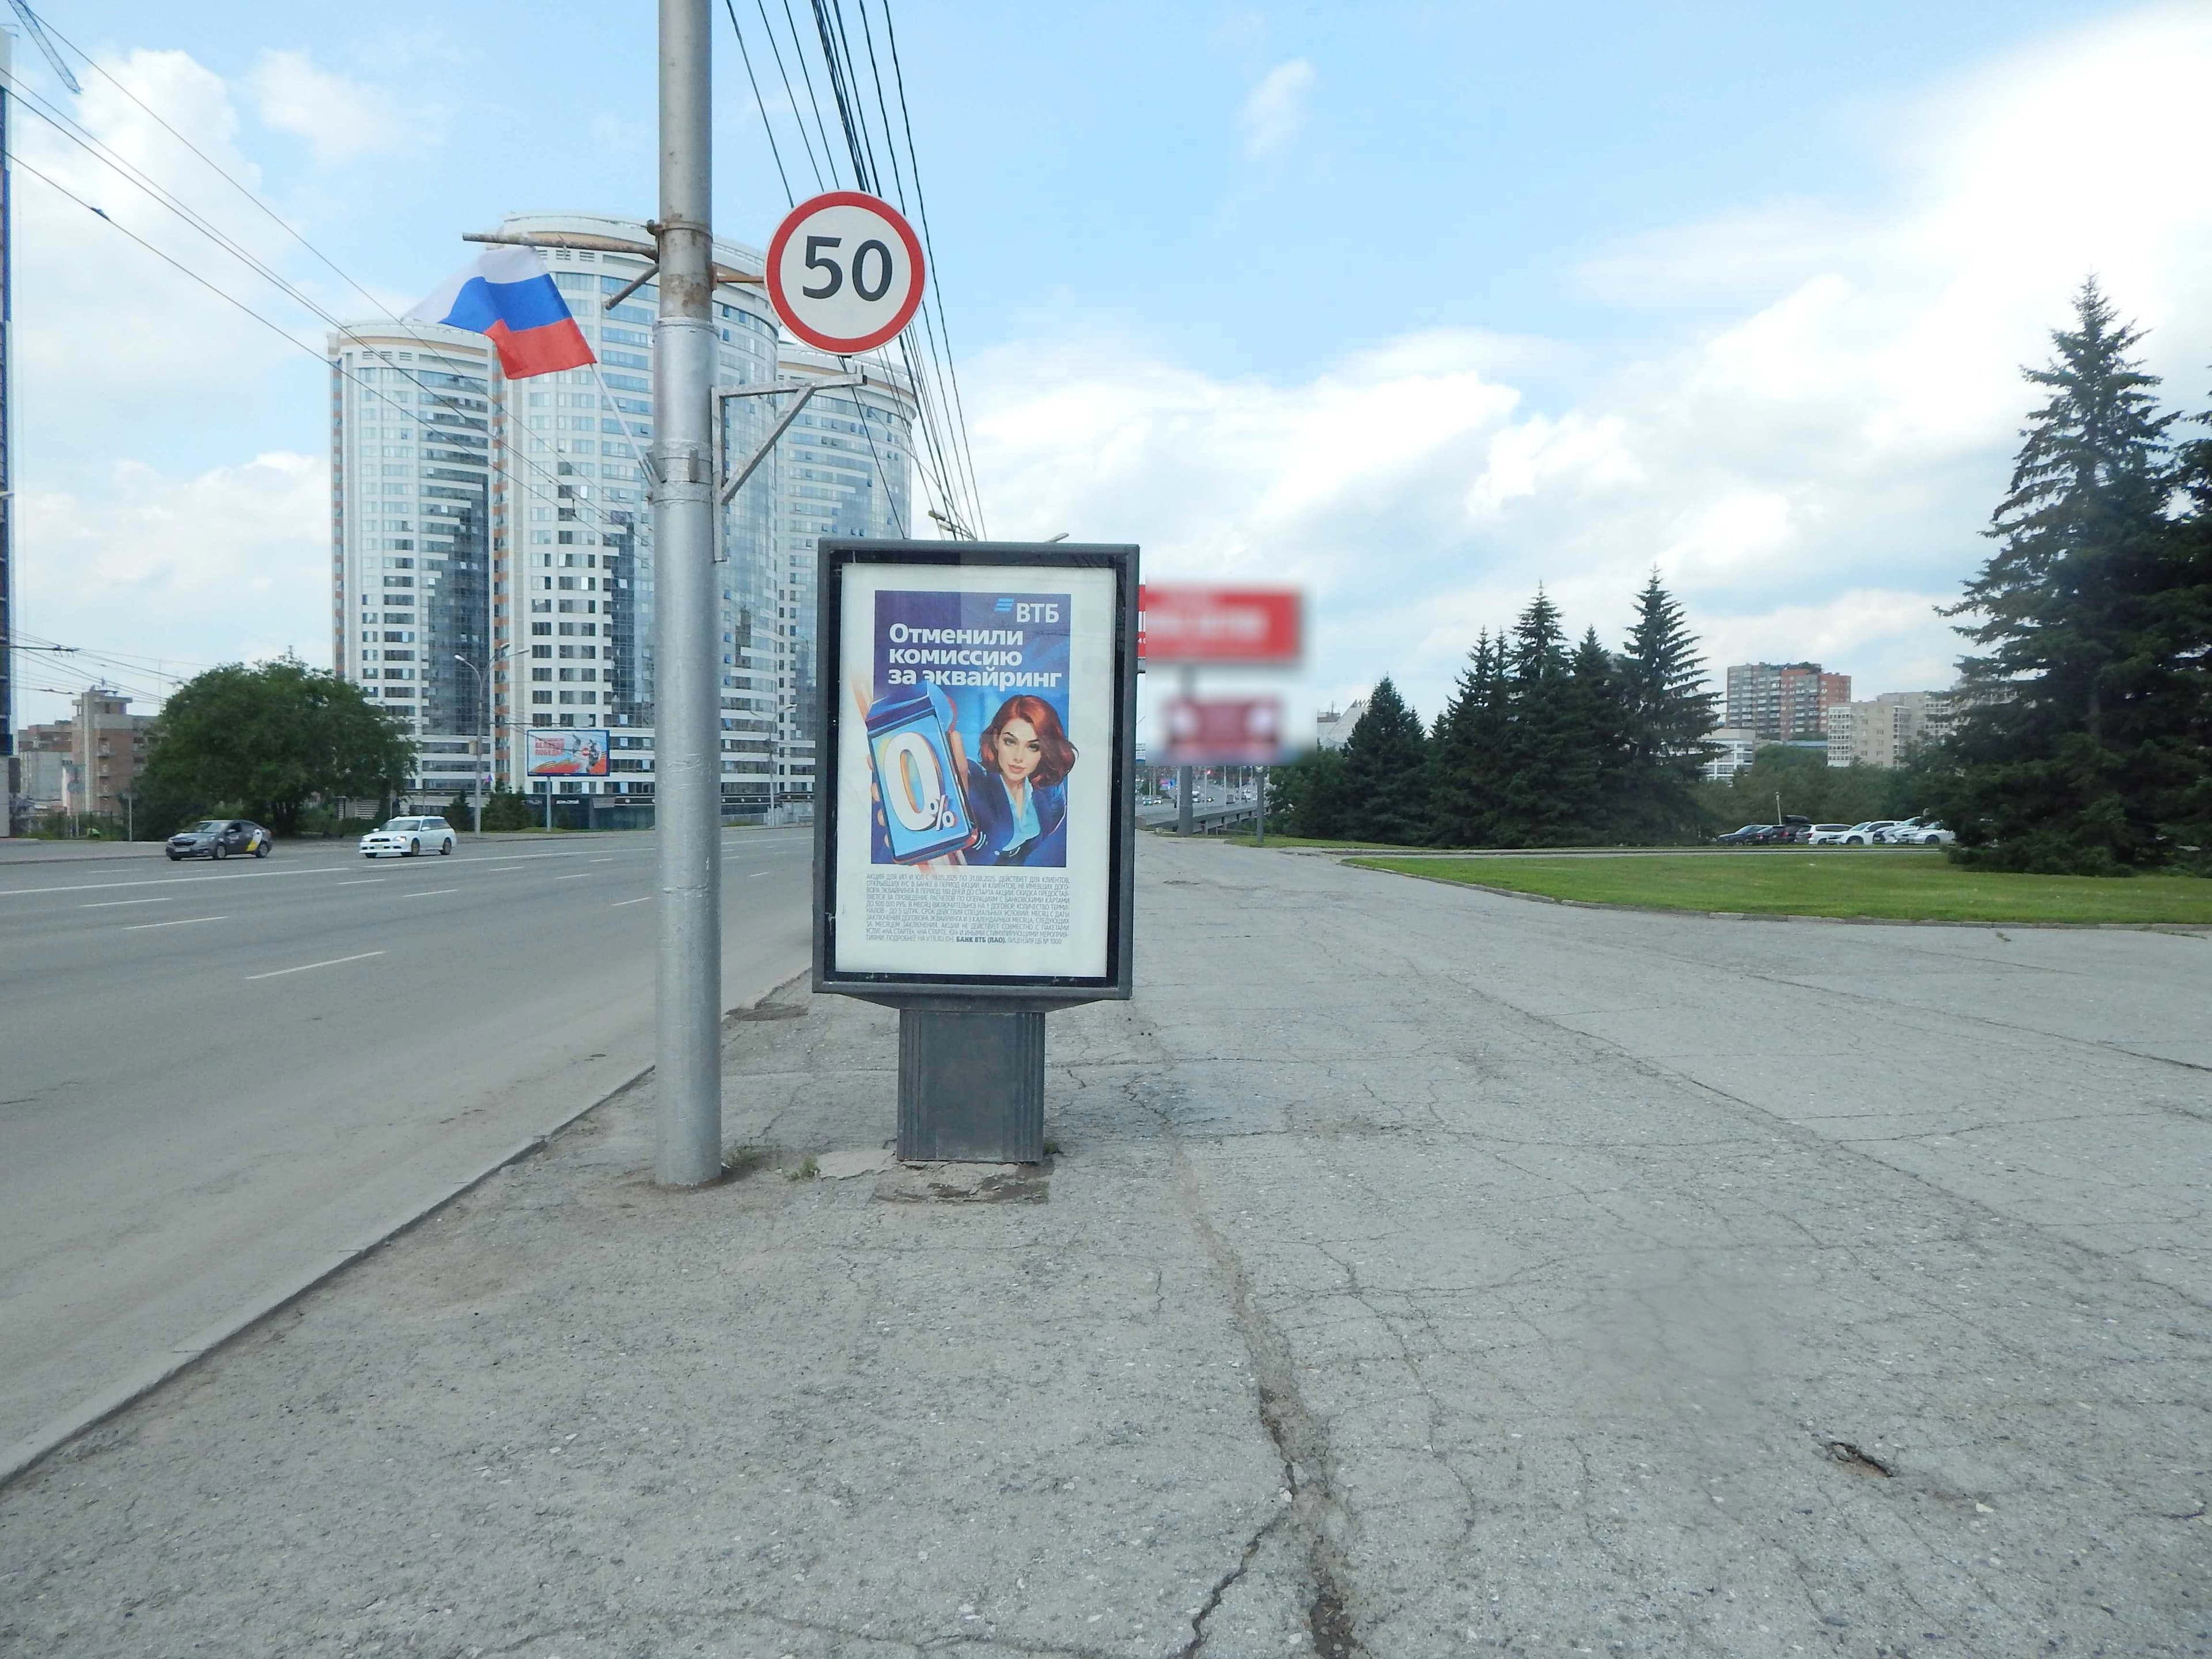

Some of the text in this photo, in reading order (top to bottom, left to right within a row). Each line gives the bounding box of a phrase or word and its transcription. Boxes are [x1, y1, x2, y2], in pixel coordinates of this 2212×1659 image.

[802, 236, 892, 301] 50
[1016, 603, 1059, 623] ВТБ
[889, 623, 1024, 645] Отменили
[889, 648, 1023, 666] комиссию
[888, 666, 1062, 692] за эквайринг
[884, 732, 956, 831] 0%
